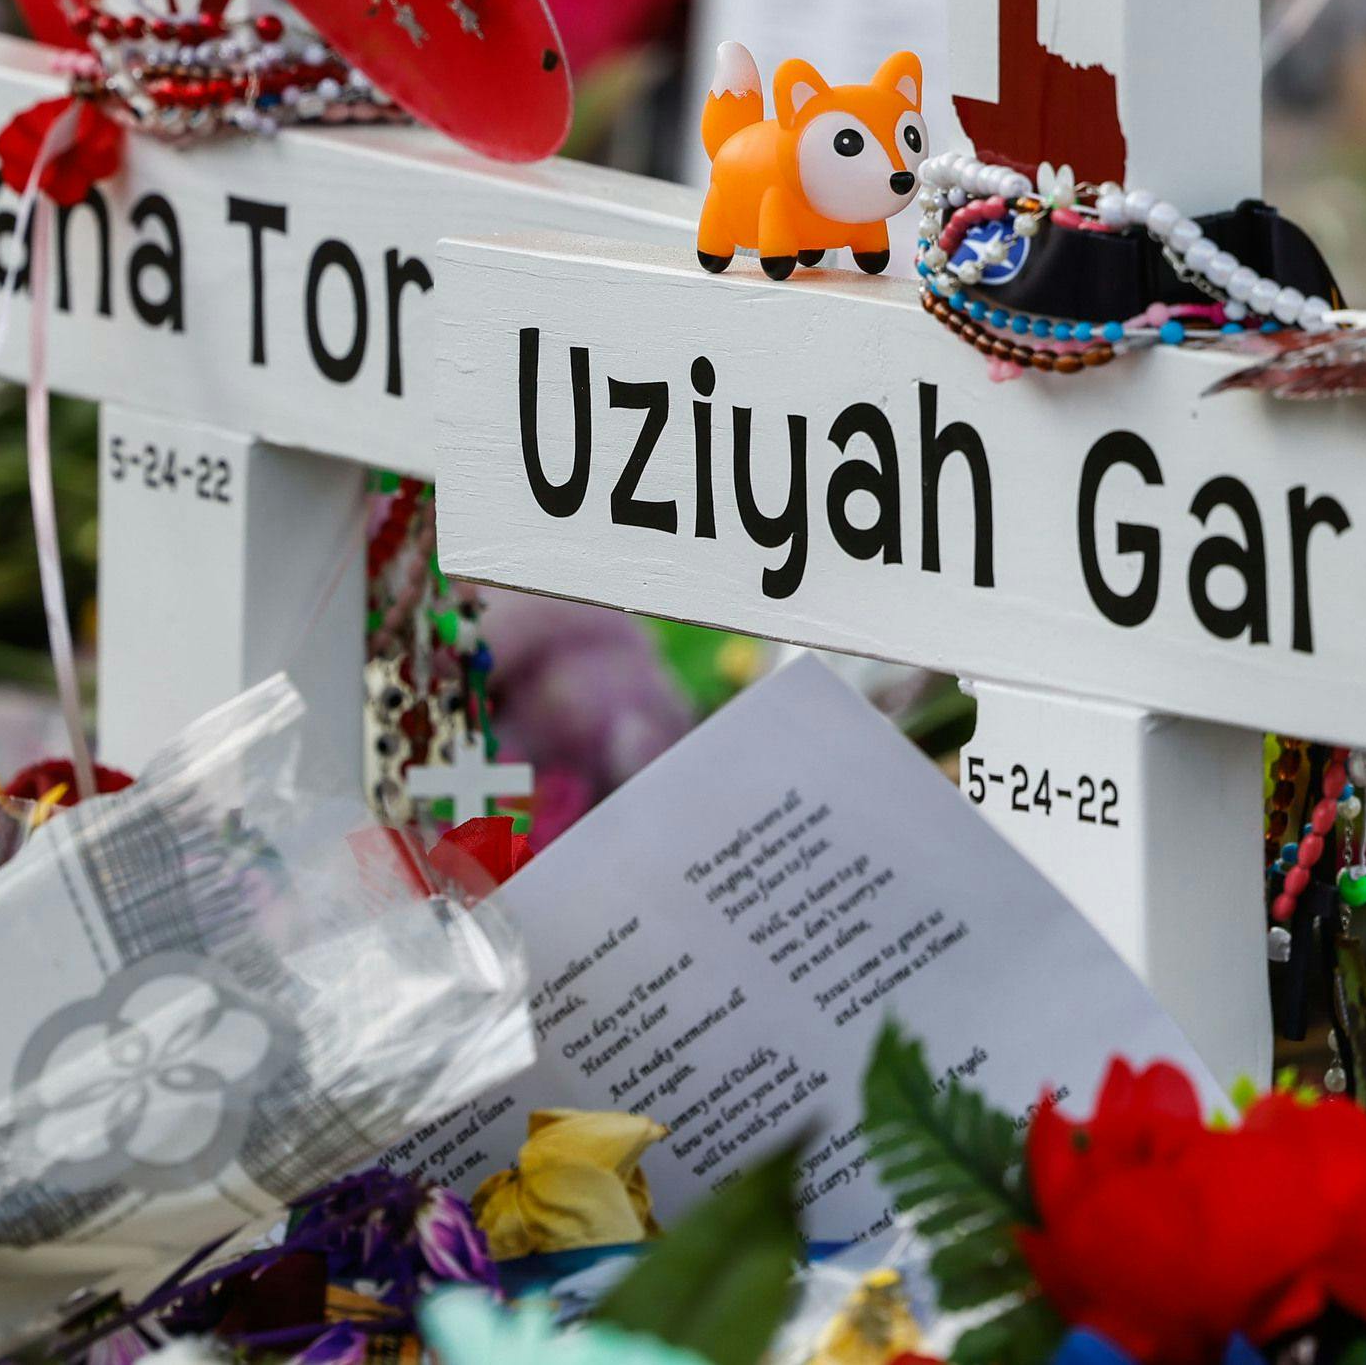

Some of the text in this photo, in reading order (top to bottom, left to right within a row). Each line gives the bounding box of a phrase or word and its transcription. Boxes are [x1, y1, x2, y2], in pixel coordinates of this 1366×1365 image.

[108, 436, 233, 504] 5-24-22
[519, 326, 996, 600] Uziyah
[965, 754, 1121, 830] 5-24-22
[683, 787, 802, 884] The angels were all
[705, 803, 831, 904] singing when we met
[721, 889, 760, 924] Jesus
[754, 869, 787, 902] face
[783, 857, 802, 875] to
[747, 854, 869, 945] Well, we have to go
[768, 867, 895, 965] now, don't worry we
[541, 954, 594, 1003] families
[592, 928, 619, 960] and
[617, 915, 640, 940] our
[788, 961, 811, 983] are
[808, 943, 835, 966] not
[812, 909, 944, 1012] Jesus came to greet us
[834, 921, 969, 1027] and welcome us Home!
[534, 994, 587, 1042] friends,
[561, 952, 693, 1059] One day we'll meet at
[579, 1003, 668, 1078] Heaven's door
[608, 985, 747, 1104] And make memories all
[657, 1063, 696, 1096] again.
[707, 1073, 733, 1103] and
[728, 1047, 779, 1084] Daddy,
[945, 1046, 988, 1090] Angels
[428, 1139, 456, 1166] eyes
[454, 1115, 481, 1145] and
[476, 1095, 515, 1126] listen
[671, 1055, 799, 1160] how we love you and
[691, 1071, 829, 1176] will be with you all the
[446, 1150, 488, 1181] to me,
[799, 1143, 839, 1179] your
[817, 1166, 851, 1195] carry
